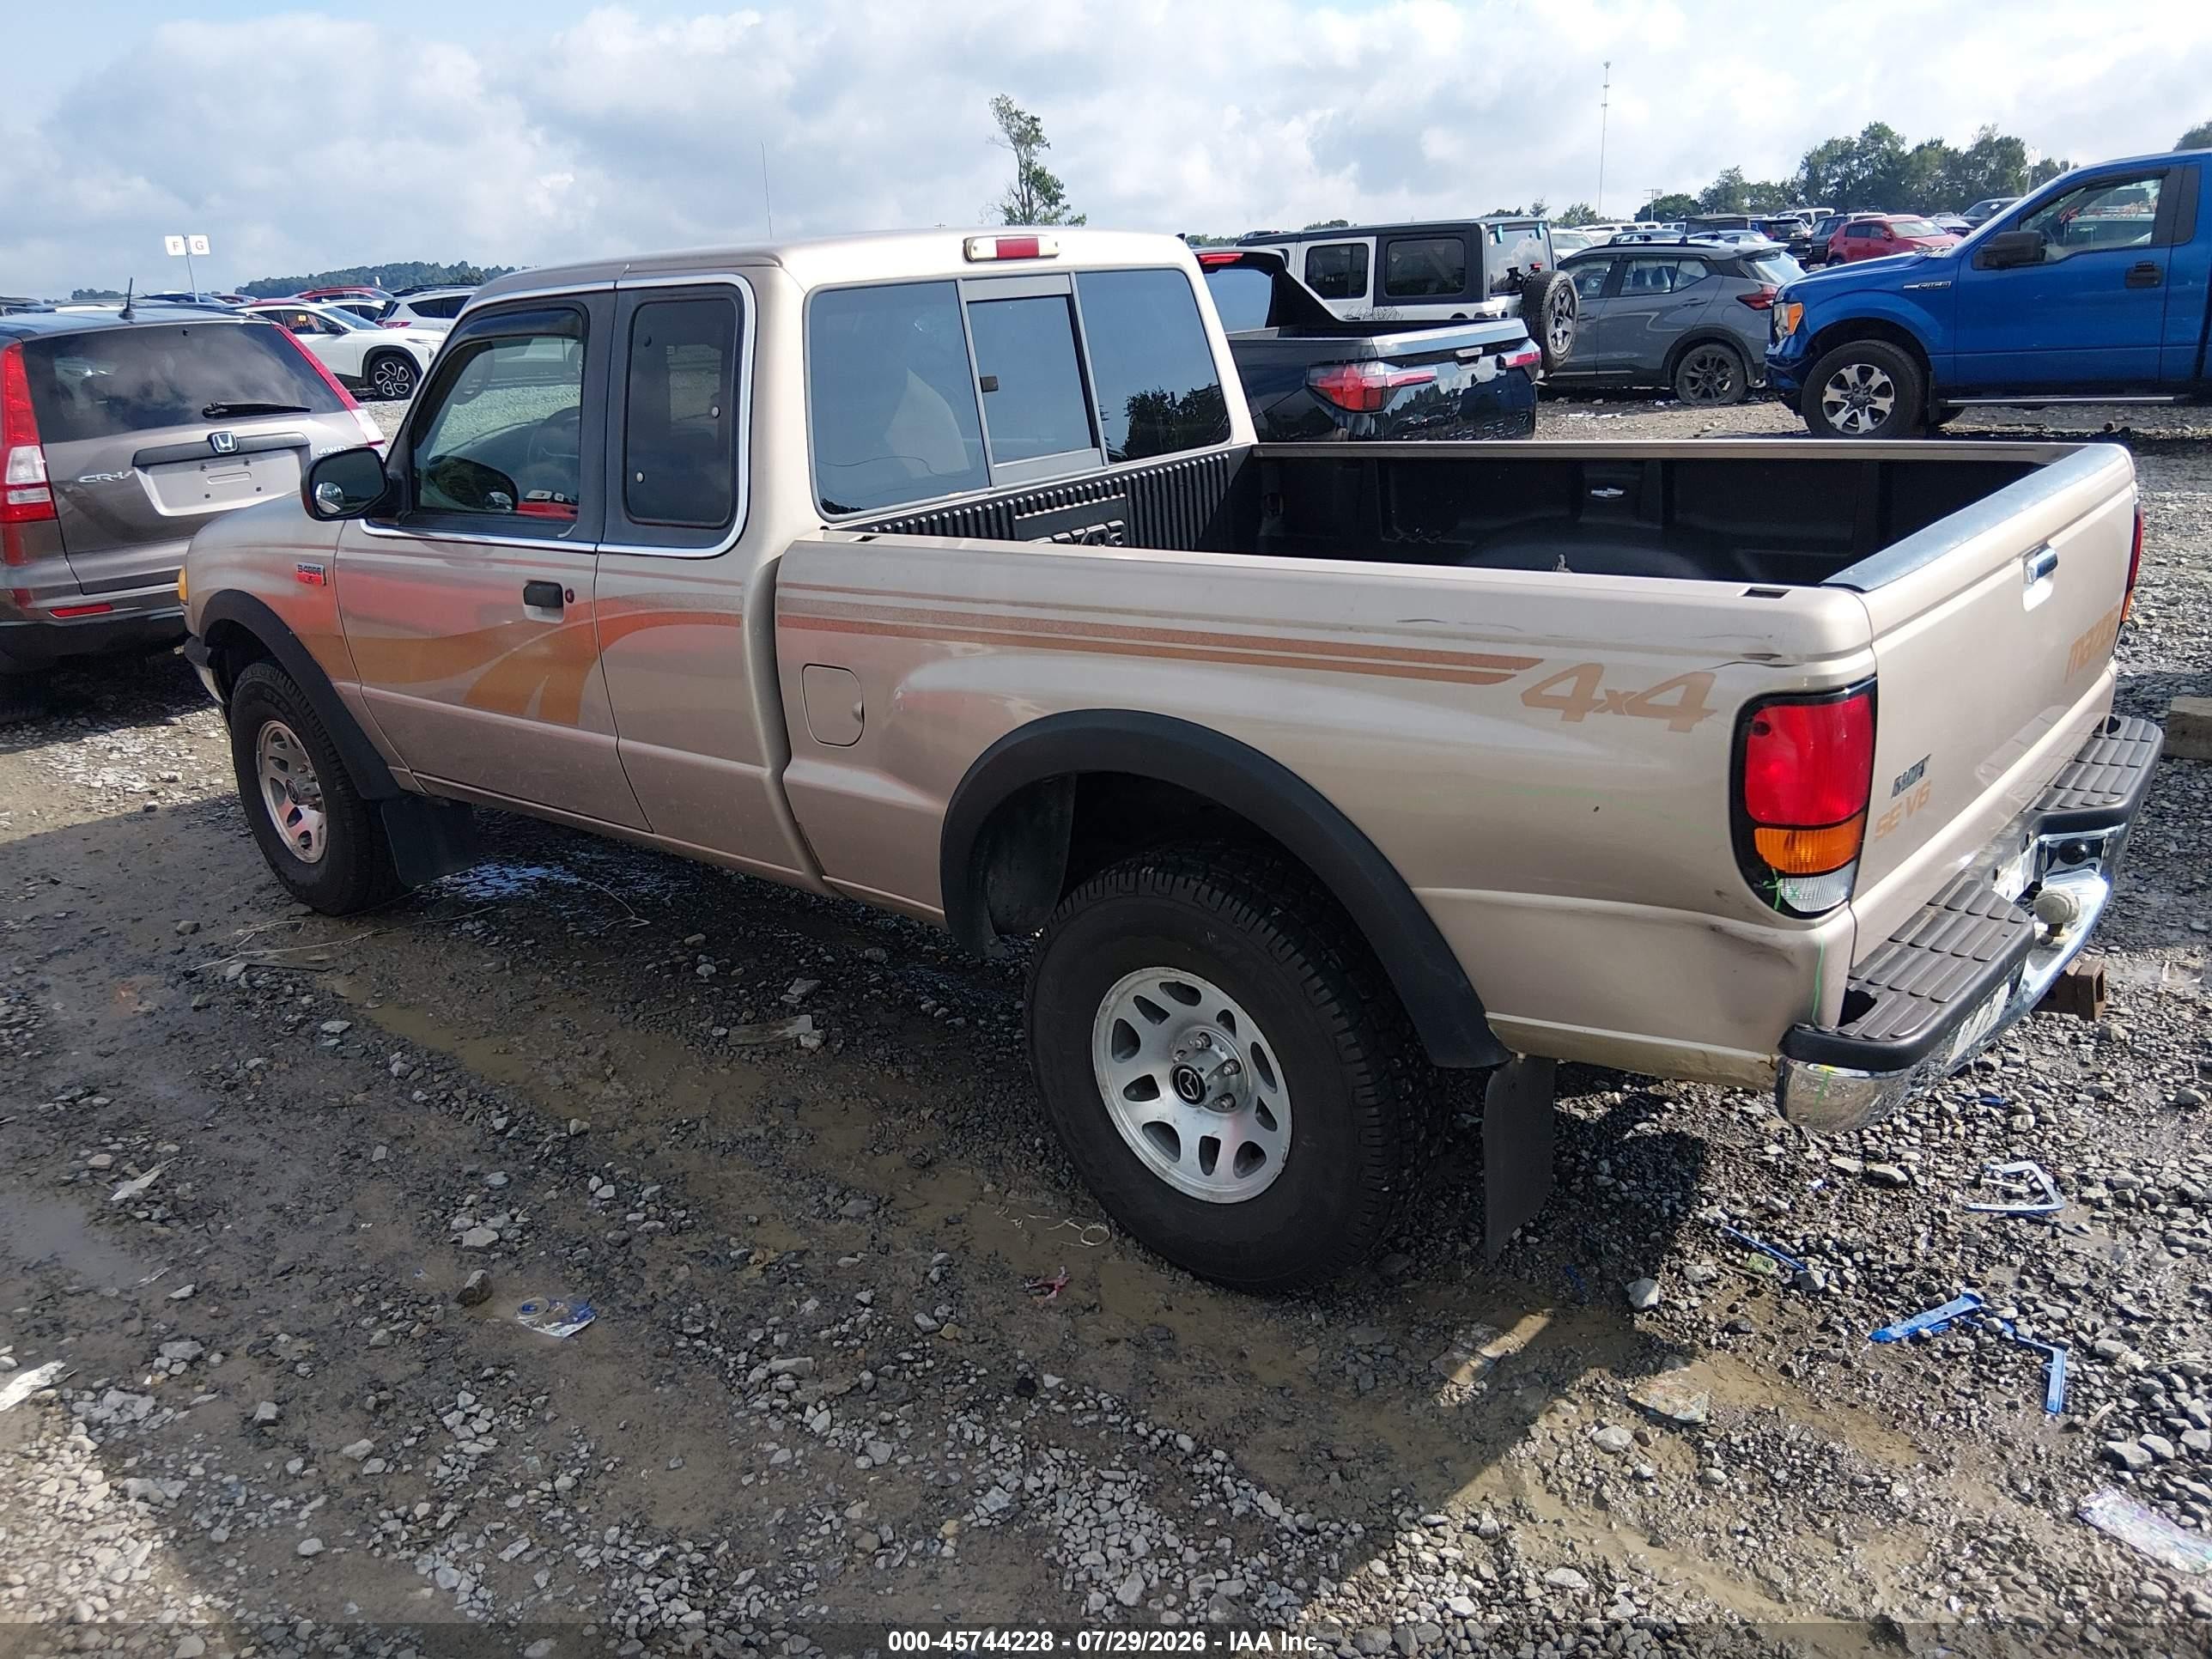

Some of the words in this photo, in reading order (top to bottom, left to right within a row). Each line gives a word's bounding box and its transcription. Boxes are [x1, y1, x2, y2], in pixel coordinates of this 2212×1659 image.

[172, 240, 179, 251] F
[195, 240, 204, 251] G
[78, 471, 134, 483] CR-V
[1521, 662, 1717, 732] 4x4
[1905, 777, 1931, 818] V6
